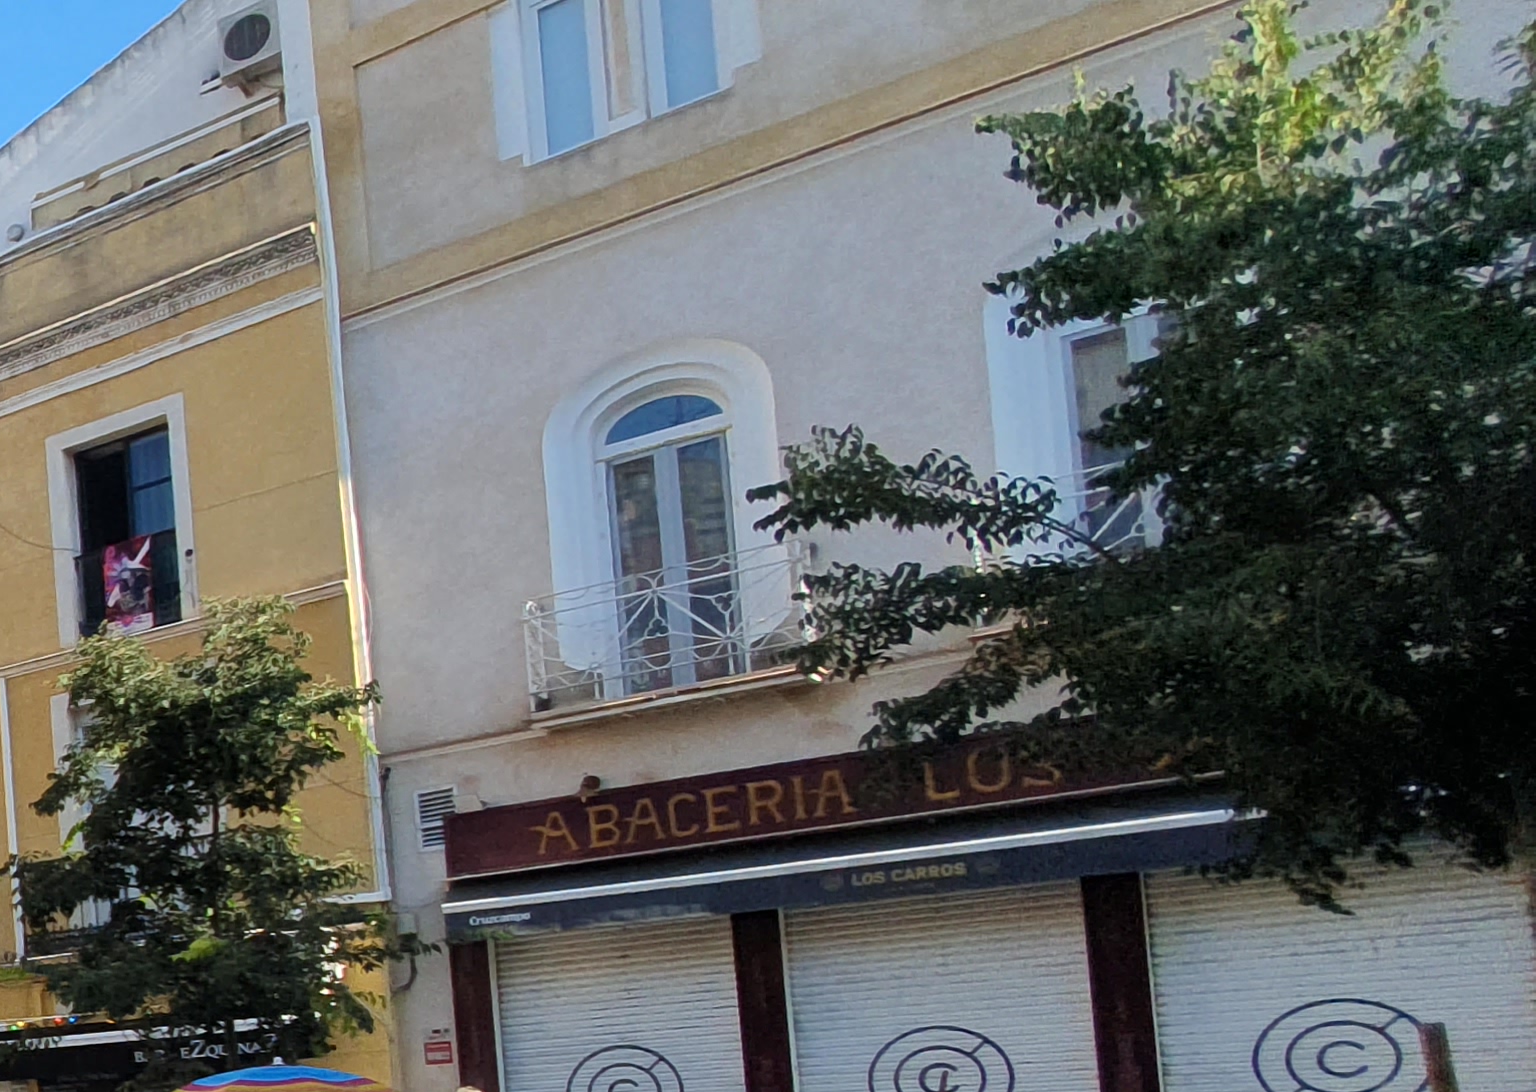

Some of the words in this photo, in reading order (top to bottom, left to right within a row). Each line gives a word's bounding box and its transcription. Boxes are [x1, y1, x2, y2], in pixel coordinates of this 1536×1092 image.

[530, 769, 858, 856] ABACERIA
[851, 871, 885, 887] LOS
[891, 861, 968, 883] CARROS
